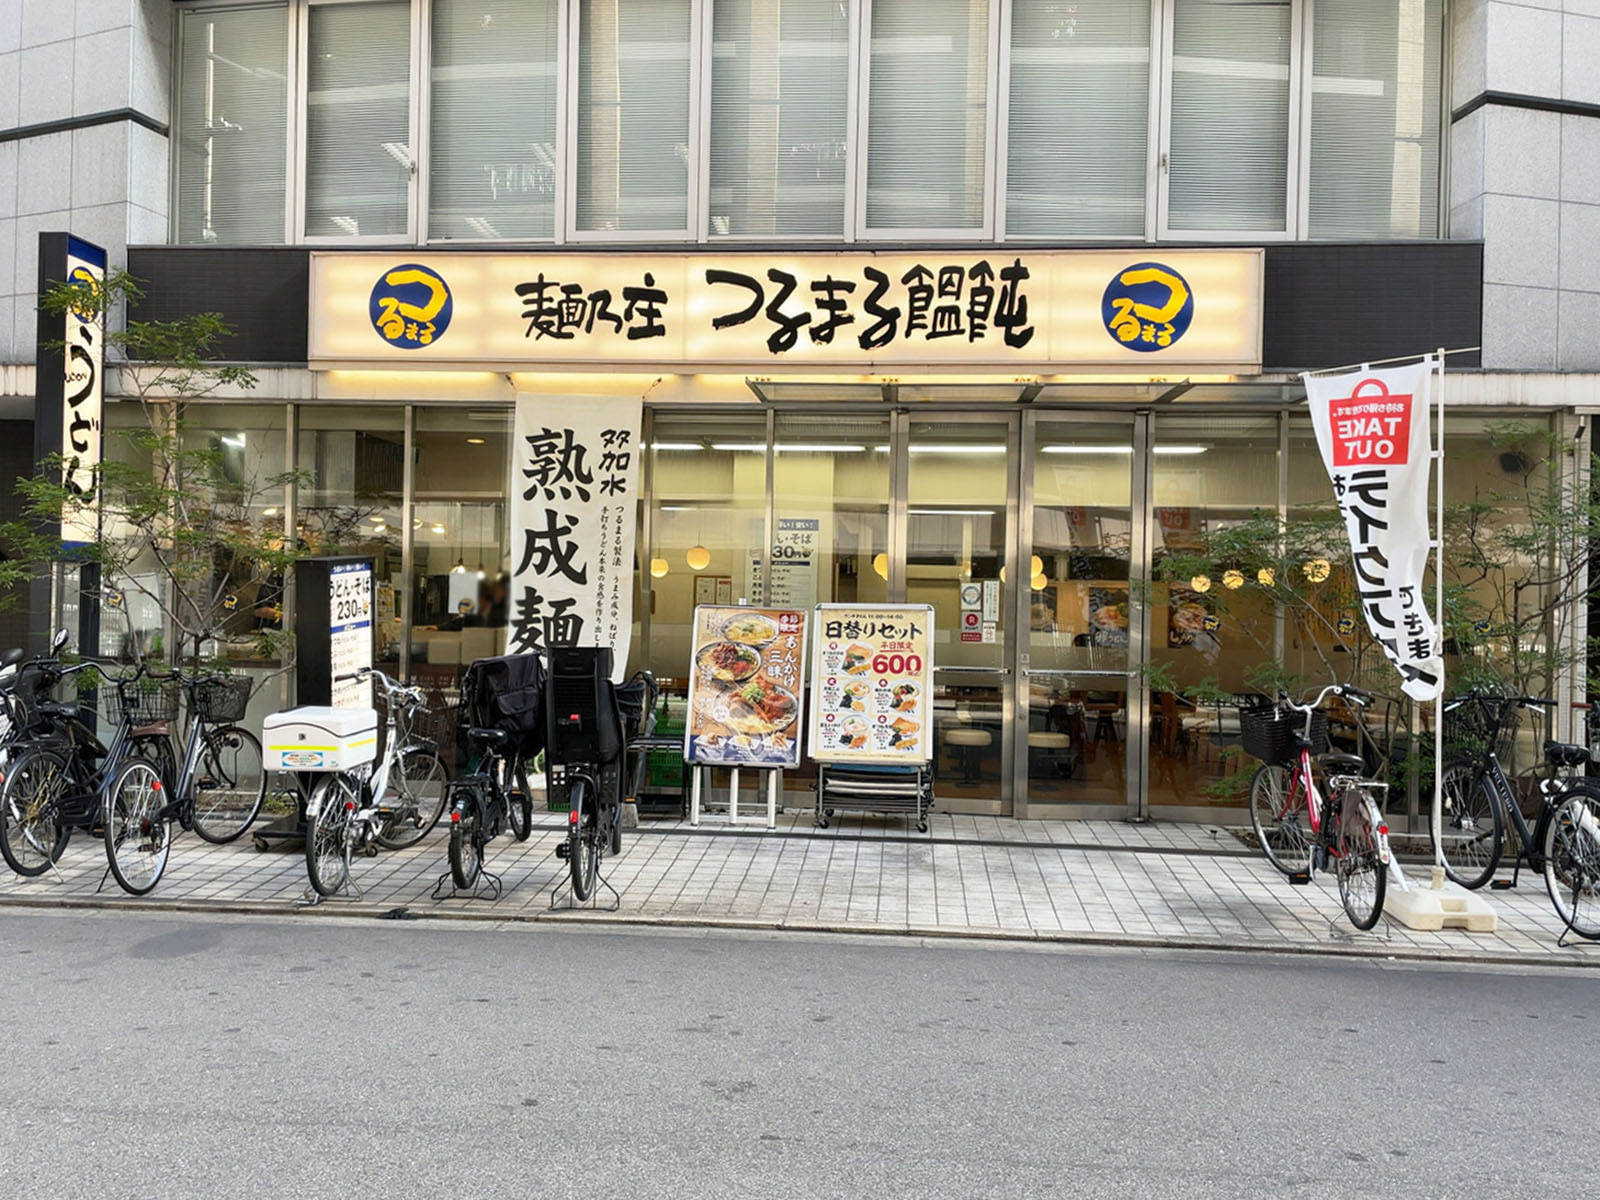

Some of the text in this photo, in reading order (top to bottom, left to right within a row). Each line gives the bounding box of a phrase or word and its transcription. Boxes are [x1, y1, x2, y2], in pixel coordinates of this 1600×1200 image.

[376, 269, 448, 344] つるまる
[706, 258, 1035, 354] つるまる饂飩
[1109, 267, 1189, 346] つるまる
[65, 325, 99, 504] うどん
[784, 636, 798, 688] あんかけ
[825, 620, 922, 640] 日替りセット
[873, 654, 922, 674] 600
